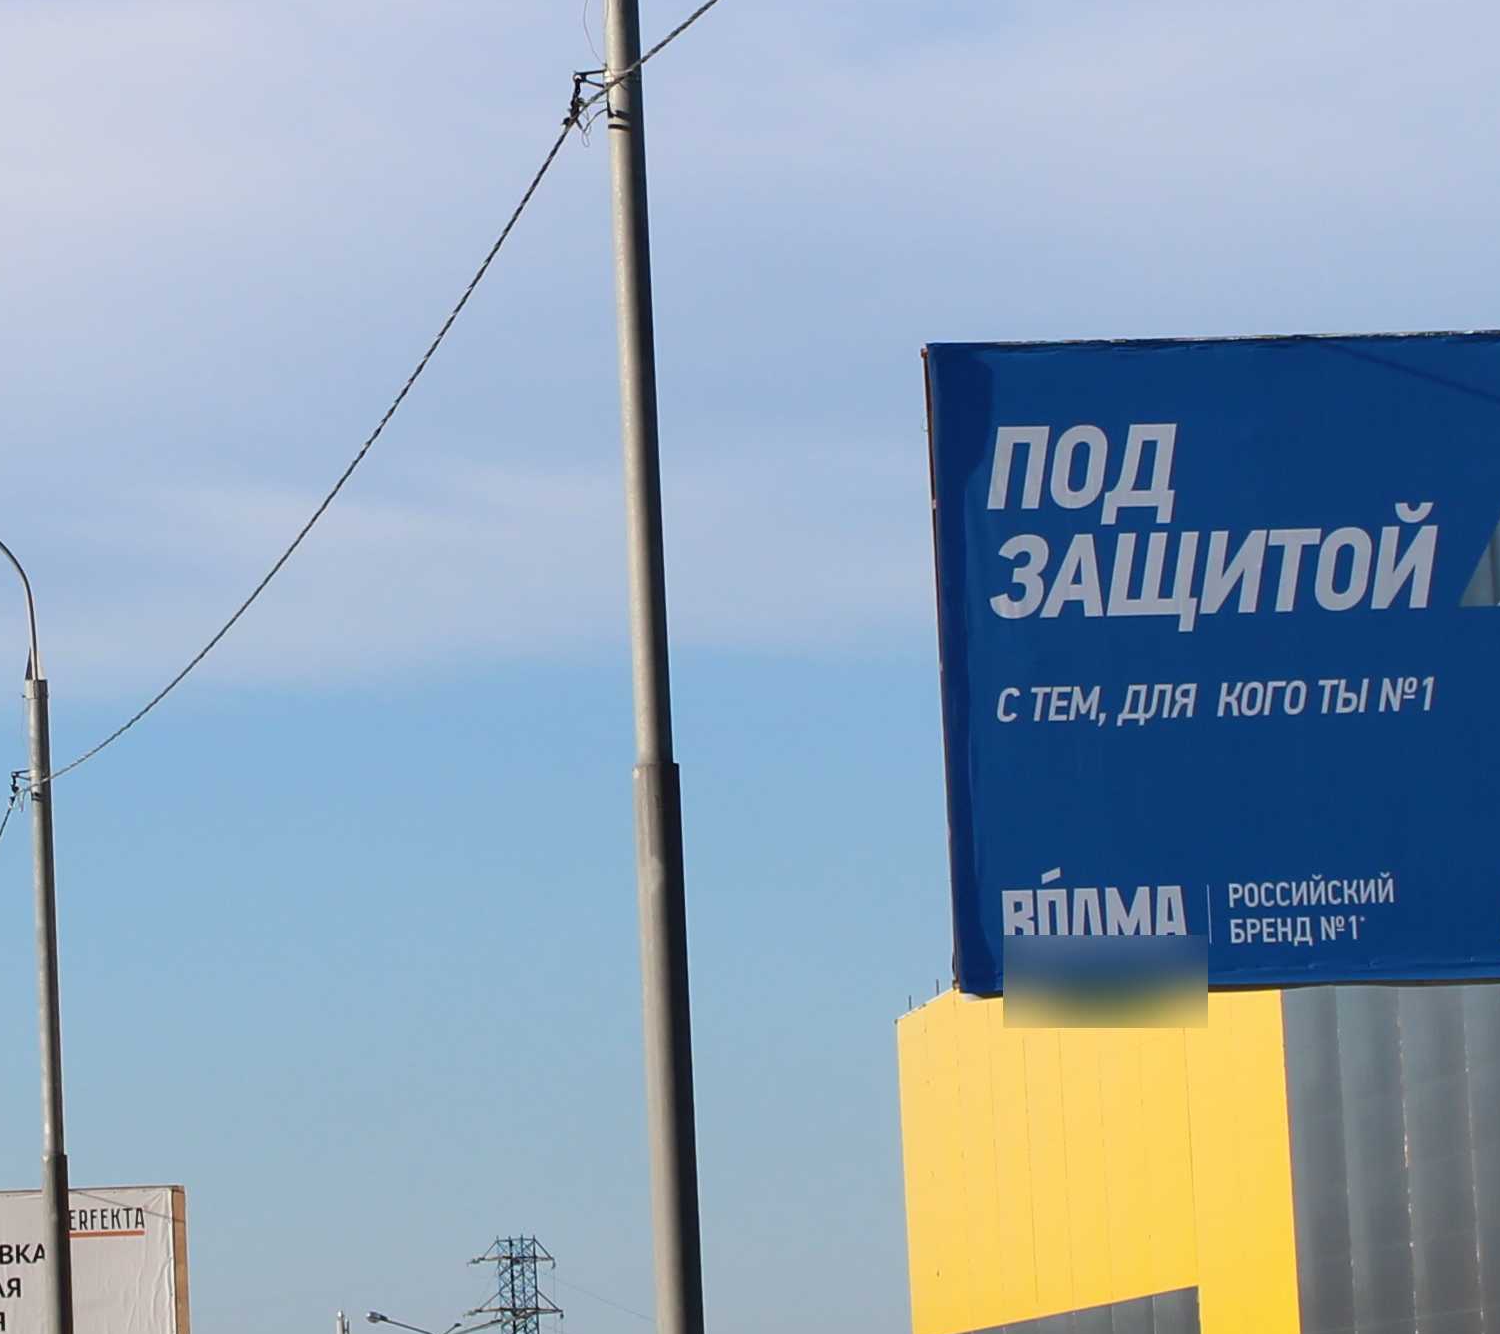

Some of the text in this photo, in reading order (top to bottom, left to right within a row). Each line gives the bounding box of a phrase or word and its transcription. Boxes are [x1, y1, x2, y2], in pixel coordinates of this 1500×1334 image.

[986, 423, 1178, 526] ПОД
[989, 502, 1440, 632] ЗАЩИТОЙ
[996, 676, 1436, 727] С ТЕМ, ДЛЯ КОГО ТЫ №1
[1228, 872, 1396, 908] РОССИЙСКИЙ
[1229, 917, 1314, 947] БРЕНД
[69, 1207, 145, 1230] ERFEKTA
